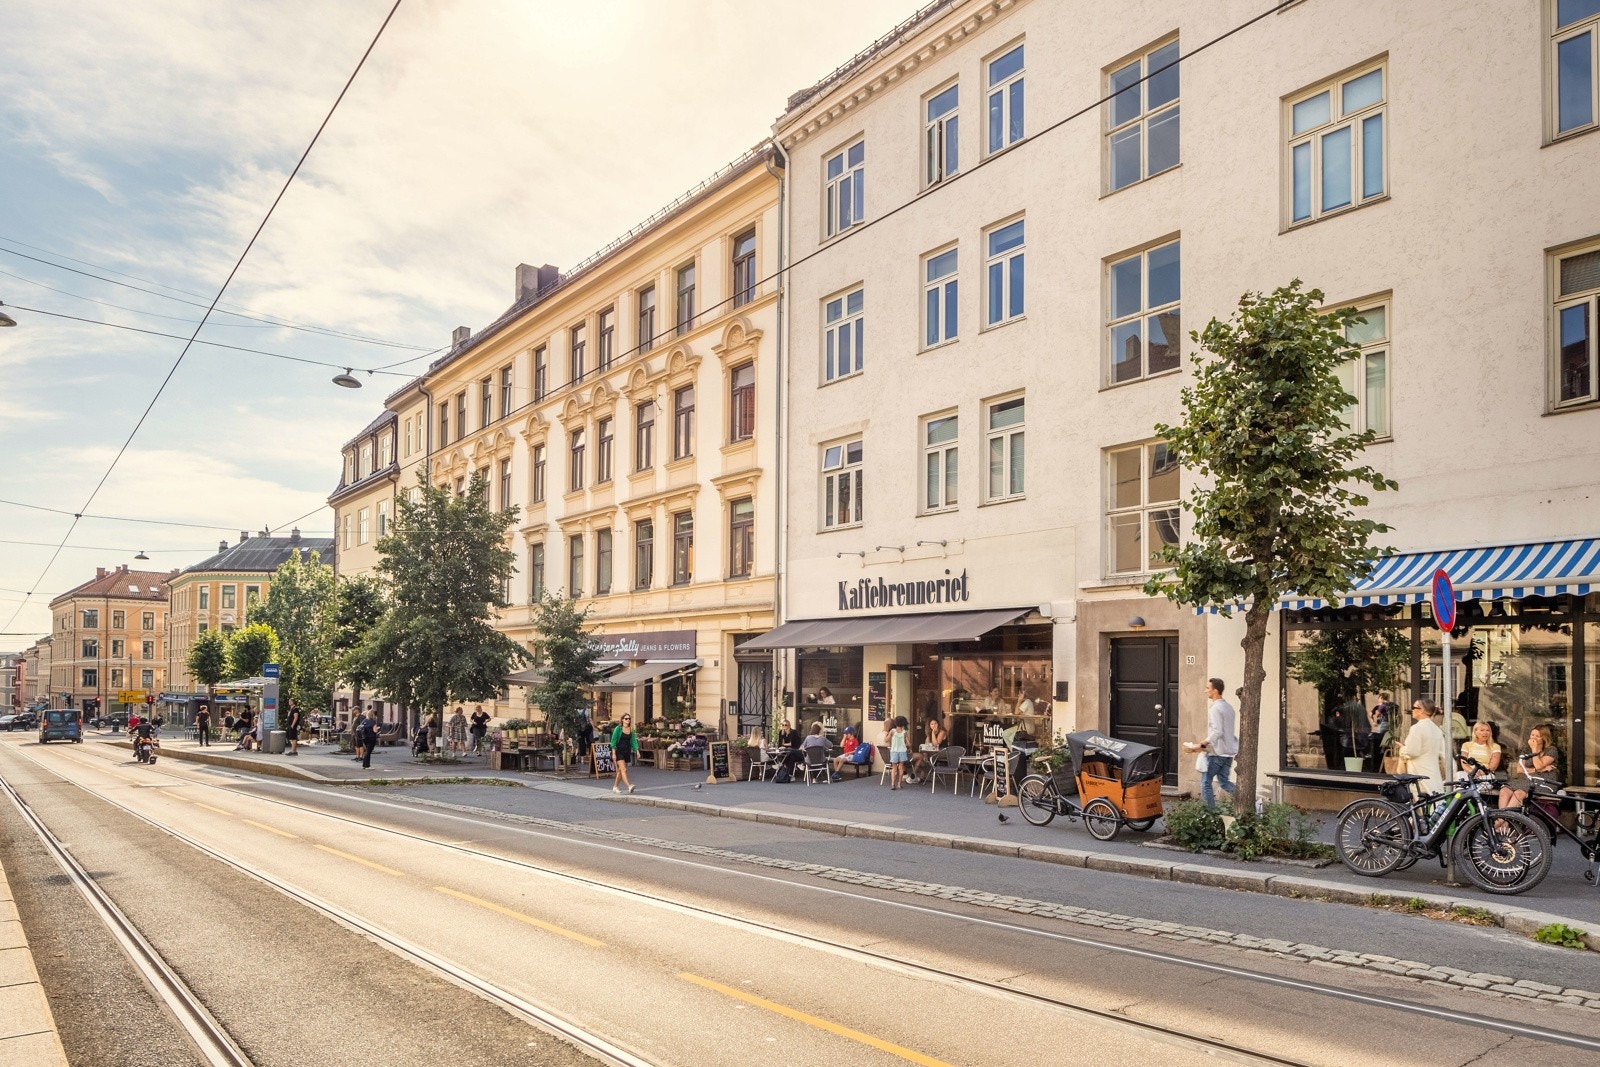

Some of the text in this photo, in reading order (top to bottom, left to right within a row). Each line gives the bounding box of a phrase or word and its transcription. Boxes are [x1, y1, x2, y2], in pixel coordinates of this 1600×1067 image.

[838, 568, 969, 611] Kaffebrenneriet
[640, 644, 657, 652] JEANS
[664, 643, 691, 651] FLOWERS
[1187, 656, 1194, 664] 50
[983, 723, 1004, 738] Kaffe
